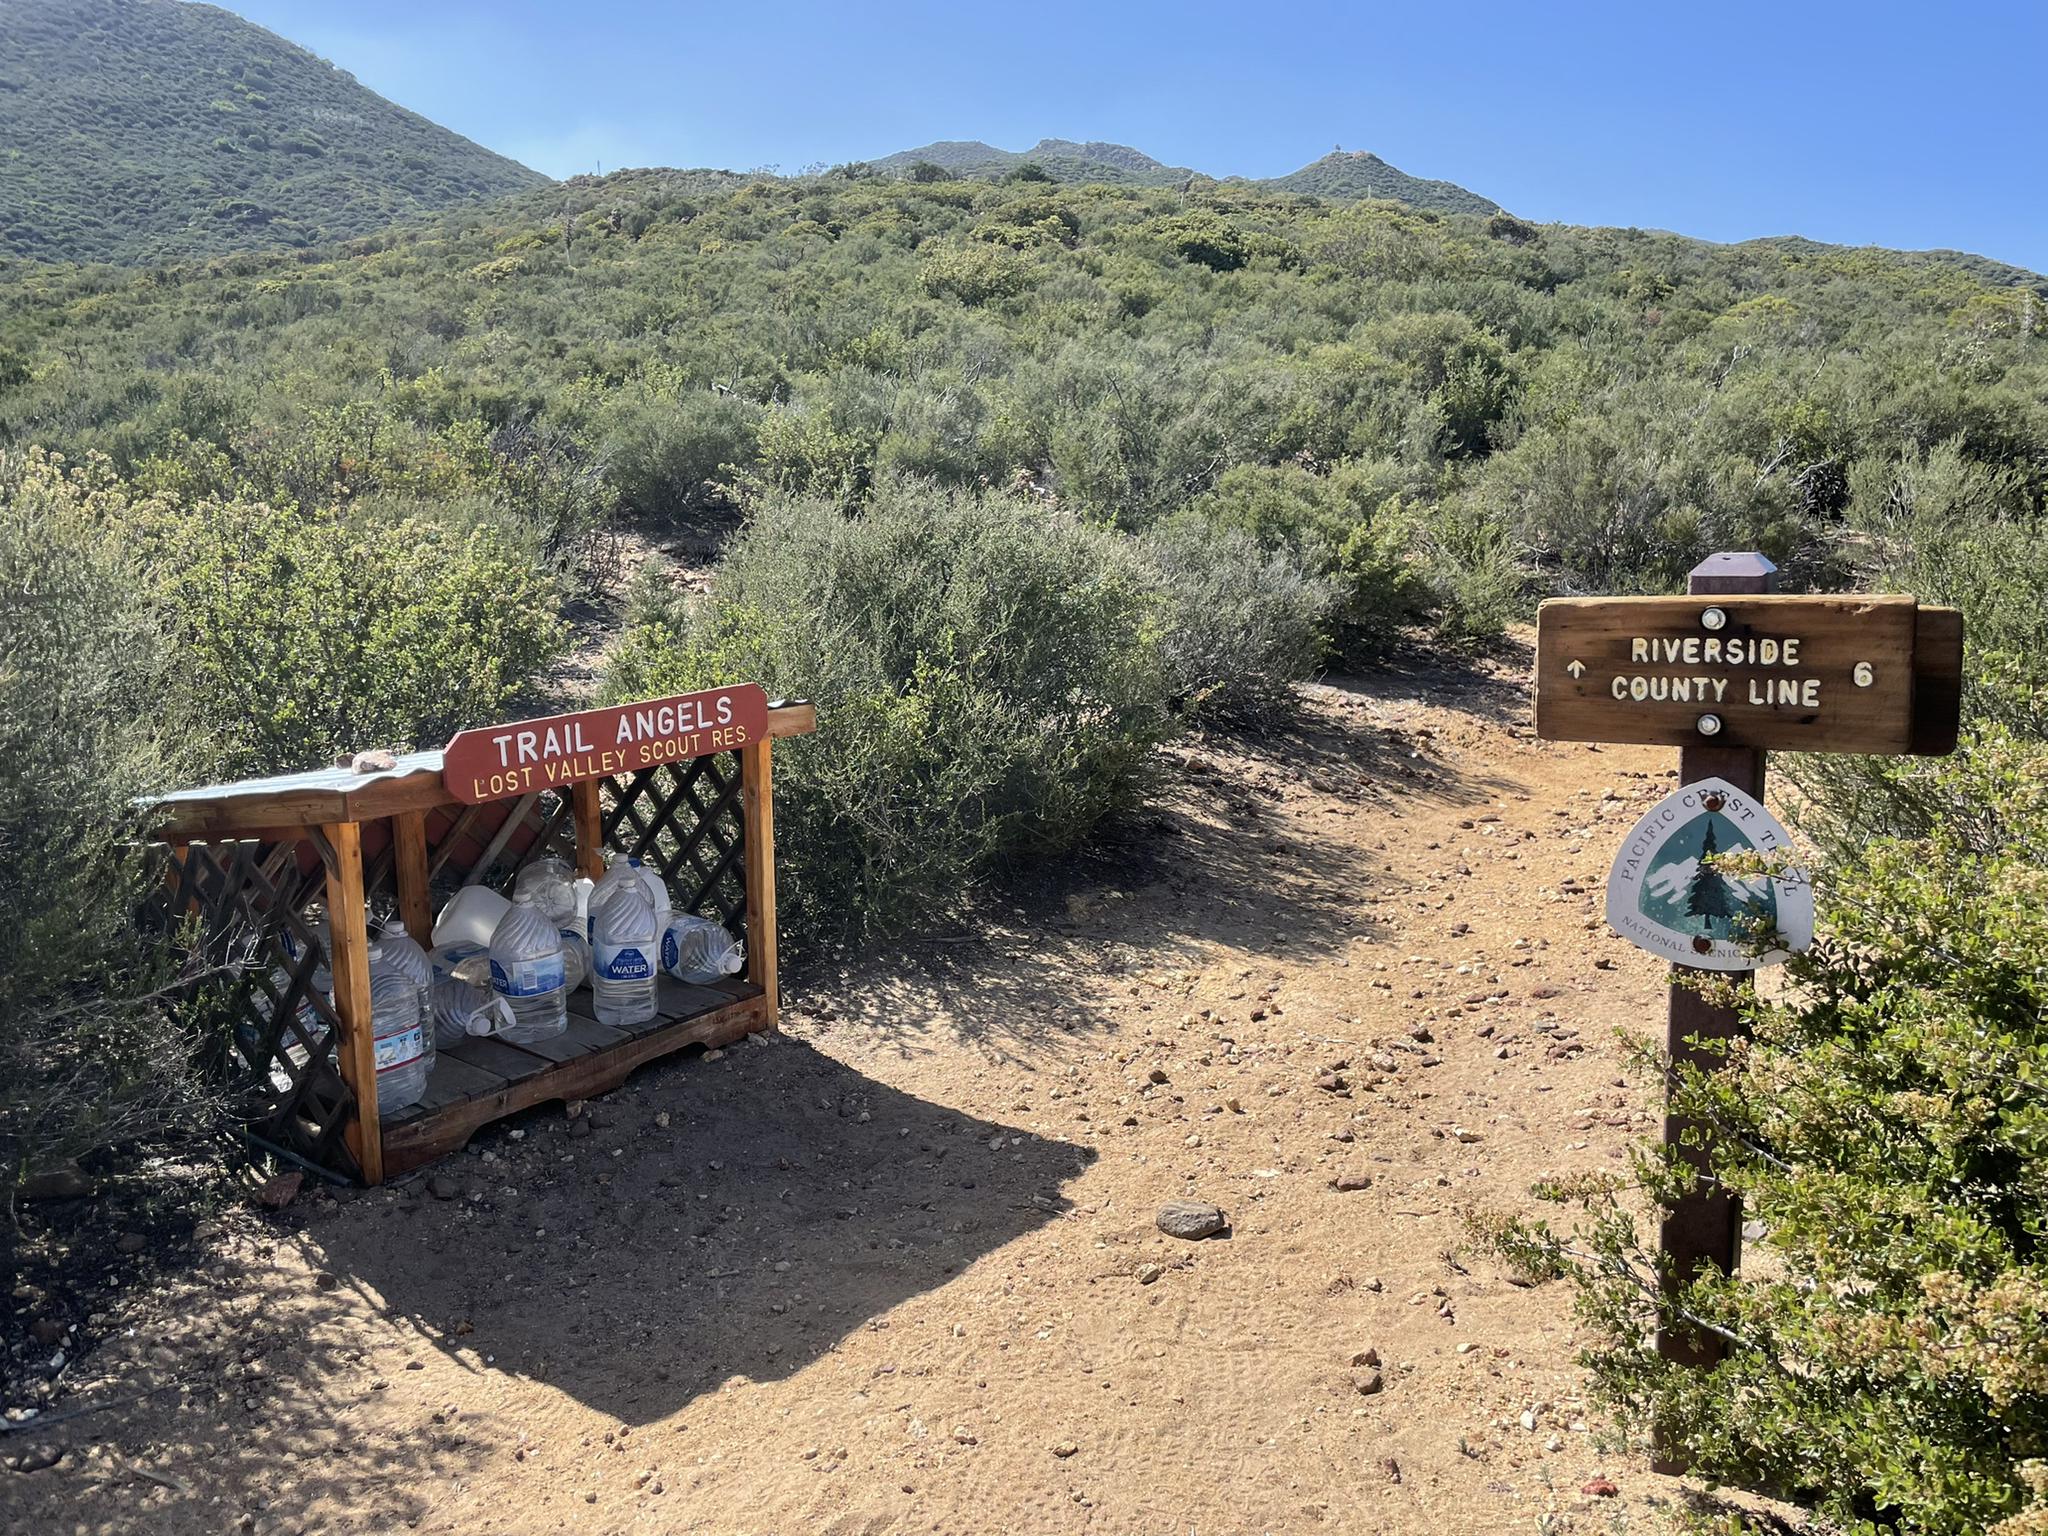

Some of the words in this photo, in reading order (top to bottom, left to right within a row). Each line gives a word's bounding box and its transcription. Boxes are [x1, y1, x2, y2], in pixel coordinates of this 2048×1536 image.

[1631, 637, 1800, 667] RIVERSIDE
[1612, 676, 1728, 702] COUNTY
[1749, 678, 1821, 707] LINE
[1853, 661, 1874, 688] 6
[492, 722, 594, 767] TRAIL
[616, 696, 733, 745] ANGELS
[473, 767, 532, 799] LOST
[544, 749, 626, 783] VALLEY
[640, 733, 701, 763] SCOUT
[712, 725, 751, 748] RES.
[1620, 808, 1675, 882] PACIFIC
[1621, 915, 1686, 953] NATIONAL
[1690, 946, 1741, 958] ENIC
[611, 964, 647, 974] WATER
